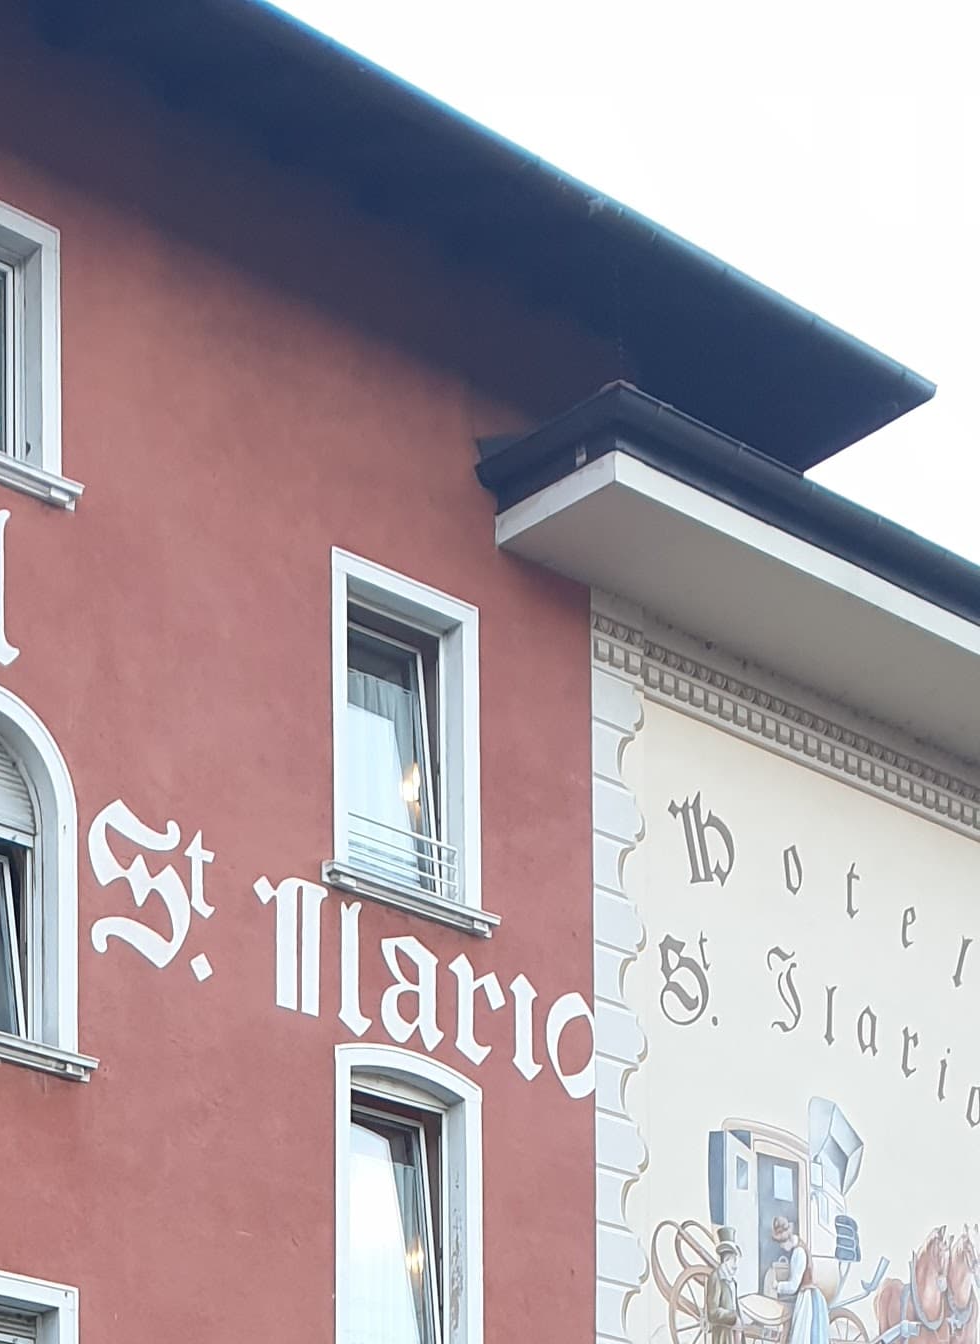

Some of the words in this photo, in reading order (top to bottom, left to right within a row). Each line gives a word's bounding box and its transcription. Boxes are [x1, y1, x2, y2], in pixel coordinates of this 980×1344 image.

[87, 798, 215, 983] St.
[253, 875, 596, 1100] Ilario
[667, 790, 974, 988] Hotel
